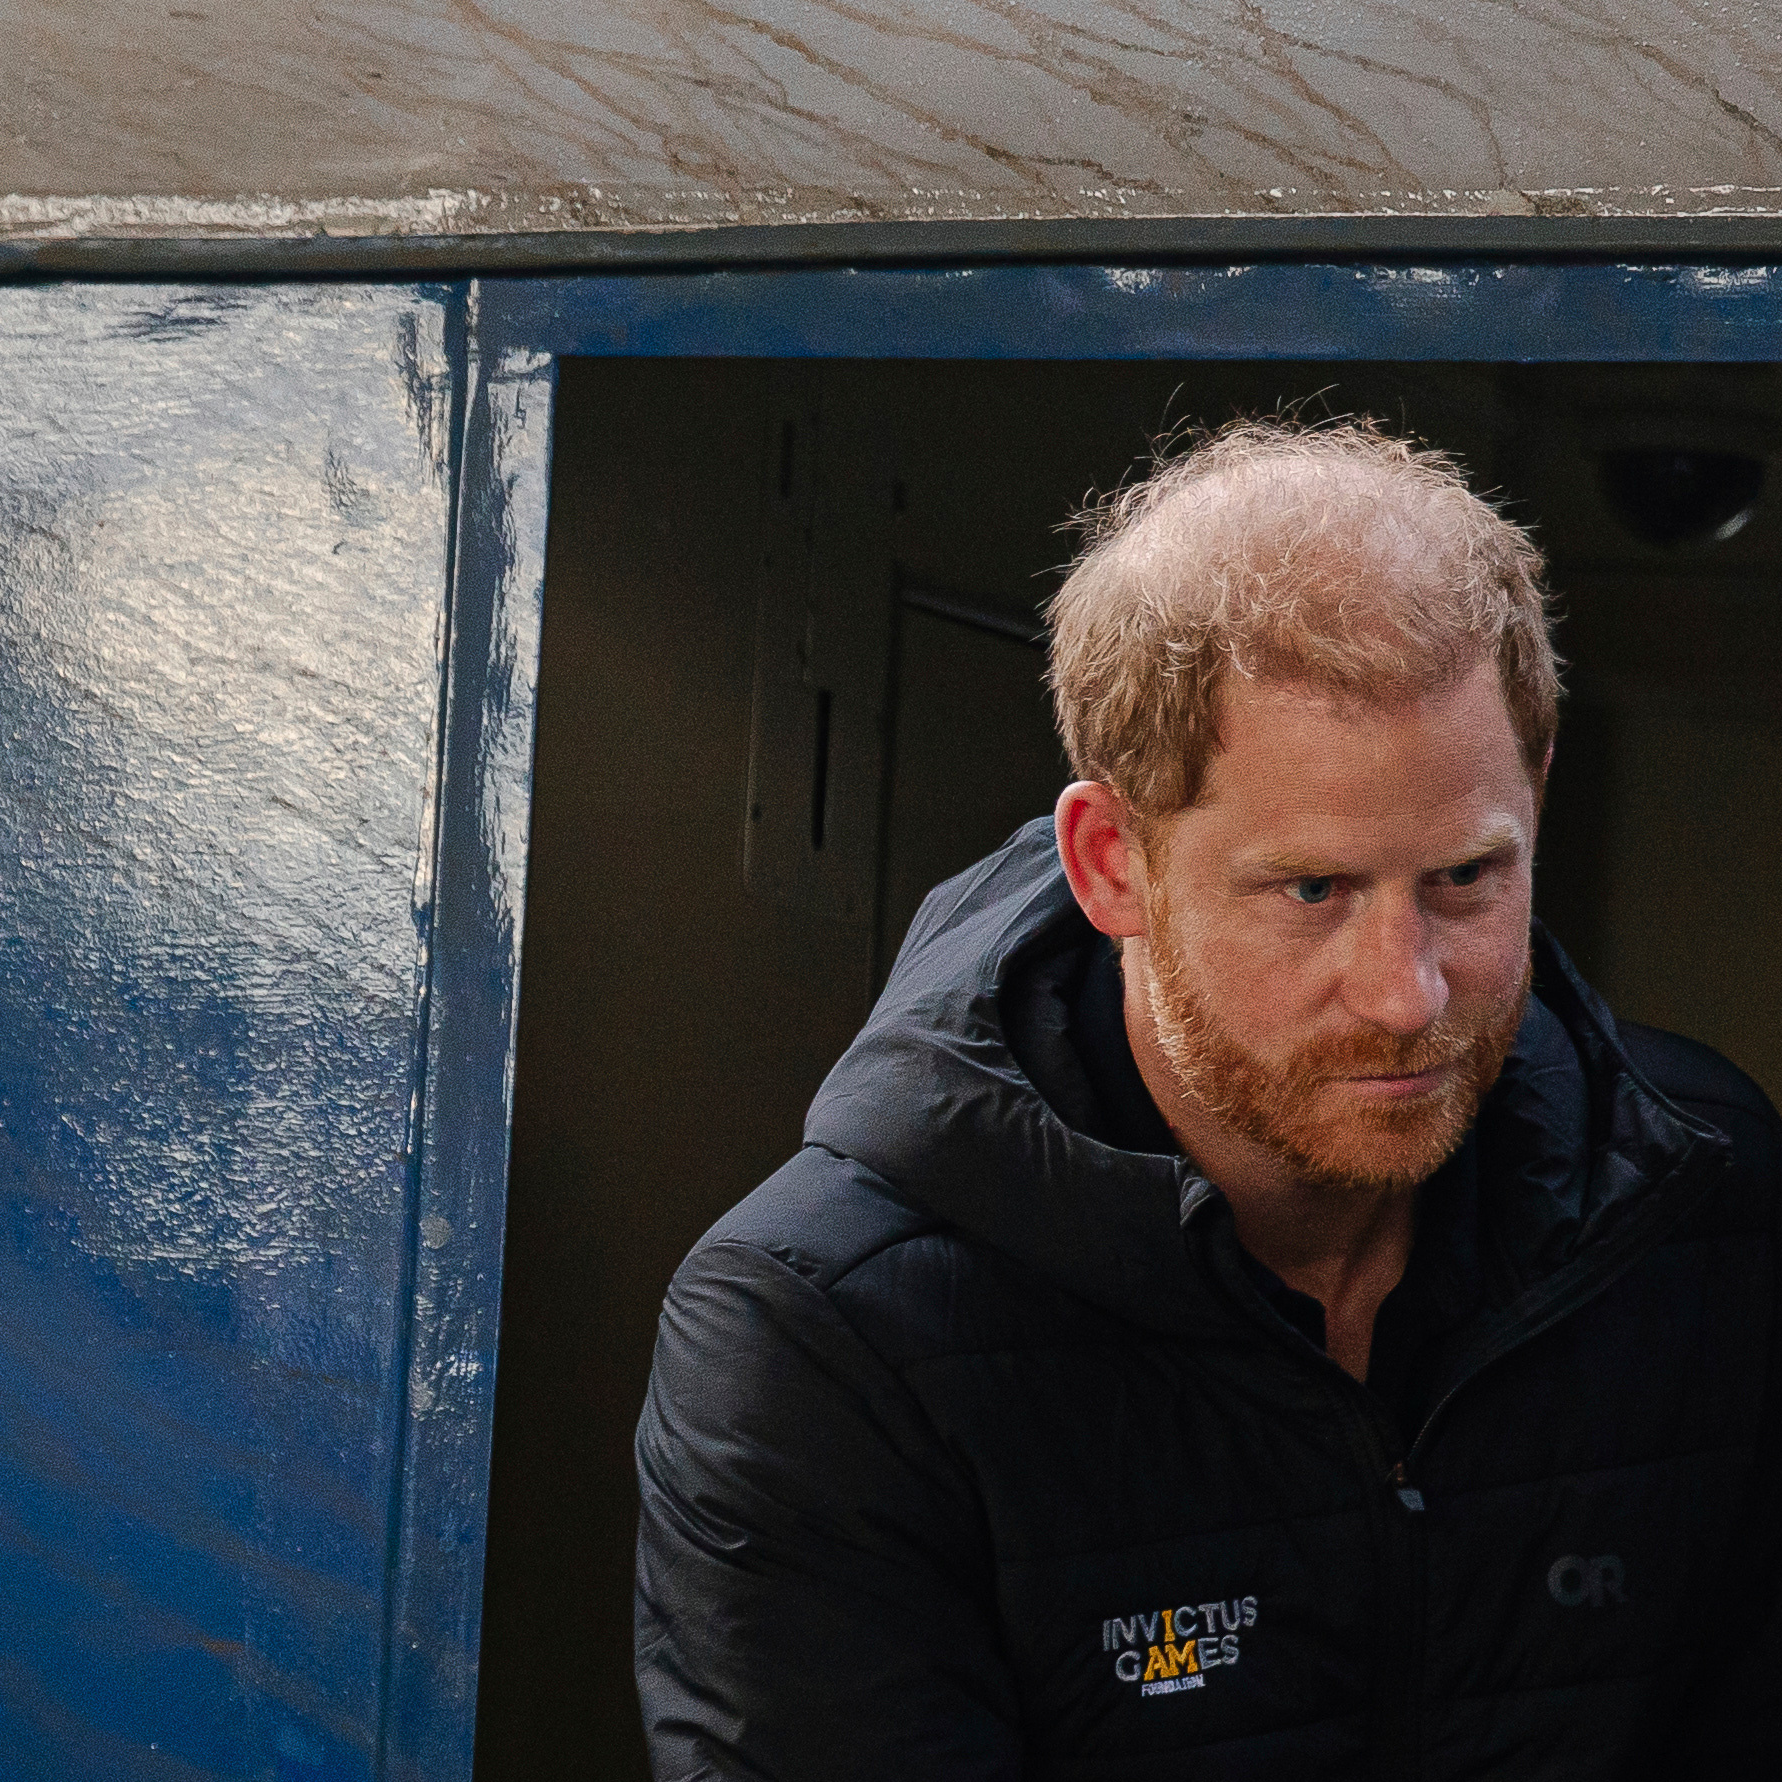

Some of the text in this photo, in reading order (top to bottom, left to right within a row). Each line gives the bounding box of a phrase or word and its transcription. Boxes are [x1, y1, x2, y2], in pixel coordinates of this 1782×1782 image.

[1547, 1554, 1627, 1608] OR
[1102, 1595, 1259, 1652] INVICTUS
[1114, 1633, 1241, 1682] GAMES
